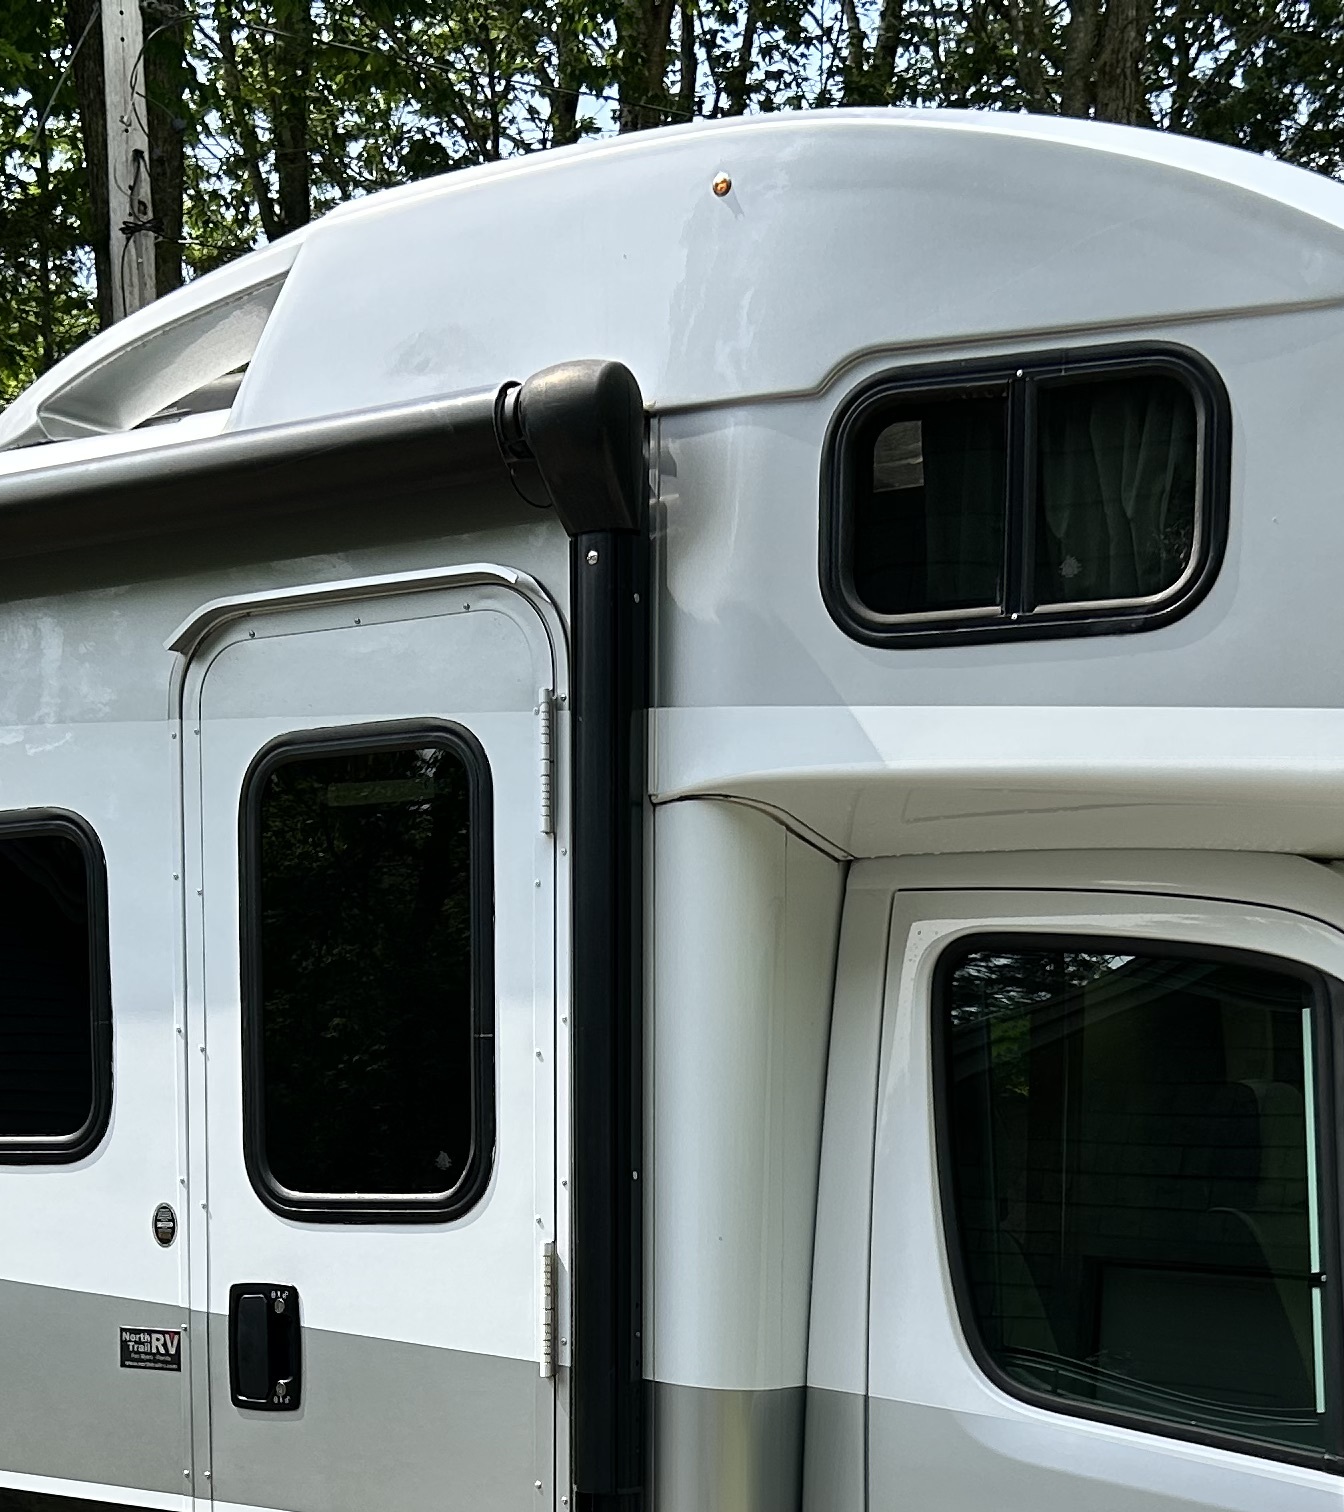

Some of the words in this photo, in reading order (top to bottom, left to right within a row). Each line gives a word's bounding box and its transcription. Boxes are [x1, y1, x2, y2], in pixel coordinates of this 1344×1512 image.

[122, 1331, 151, 1342] North
[127, 1341, 151, 1353] Trail
[151, 1333, 179, 1355] RV
